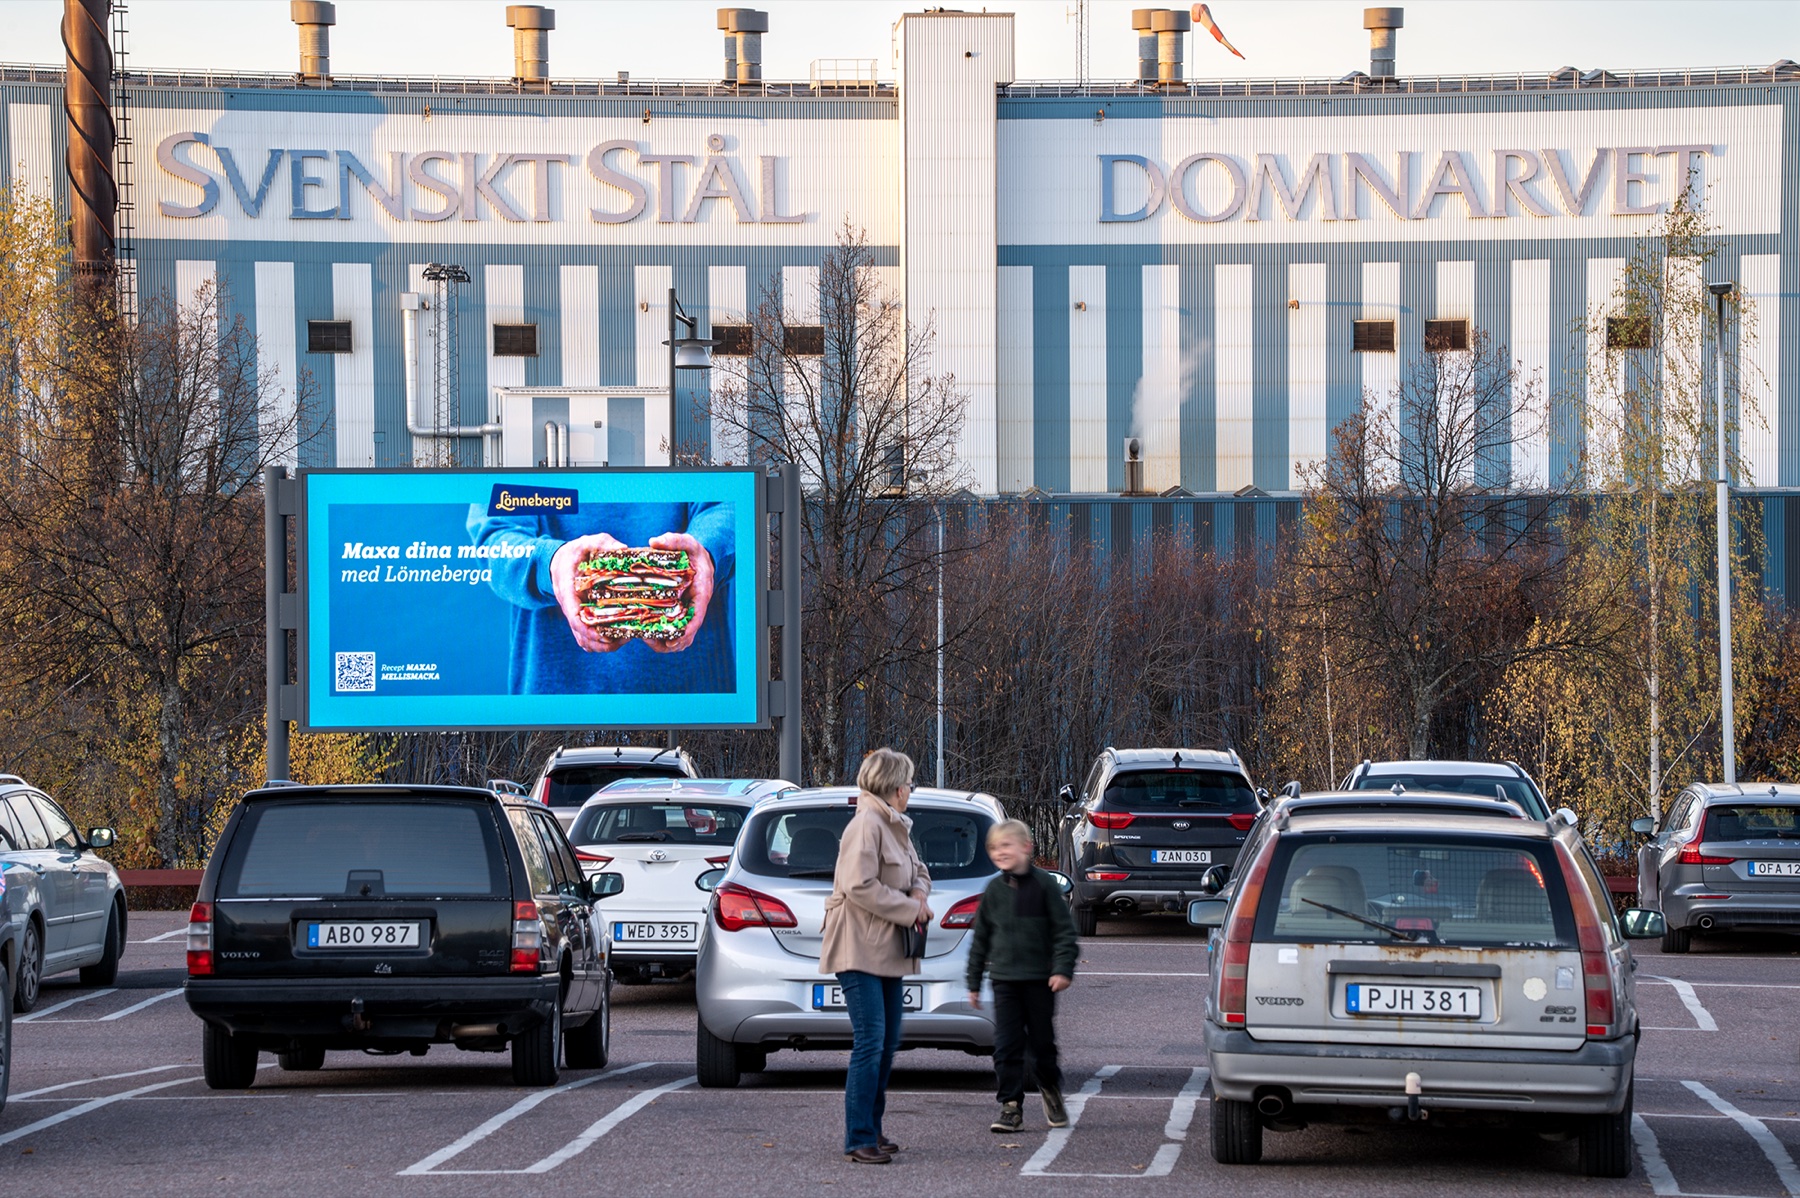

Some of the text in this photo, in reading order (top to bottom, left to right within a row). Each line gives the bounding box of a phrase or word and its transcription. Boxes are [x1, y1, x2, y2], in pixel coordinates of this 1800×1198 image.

[155, 131, 808, 224] SVENSKT STÅL
[1100, 144, 1714, 223] DOMNARVET
[495, 490, 572, 511] Lönneberga
[341, 541, 536, 559] Maxa dina mackor
[341, 565, 492, 585] med Lönneberga
[381, 663, 437, 672] Recept MAXAD
[381, 672, 440, 680] MELLISMACKA
[1161, 851, 1182, 862] ZAN
[371, 926, 411, 944] 987
[627, 925, 688, 938] WED 395
[221, 951, 260, 959] VOLVO
[1255, 996, 1305, 1006] VOLVO
[1368, 988, 1467, 1013] PJH 381
